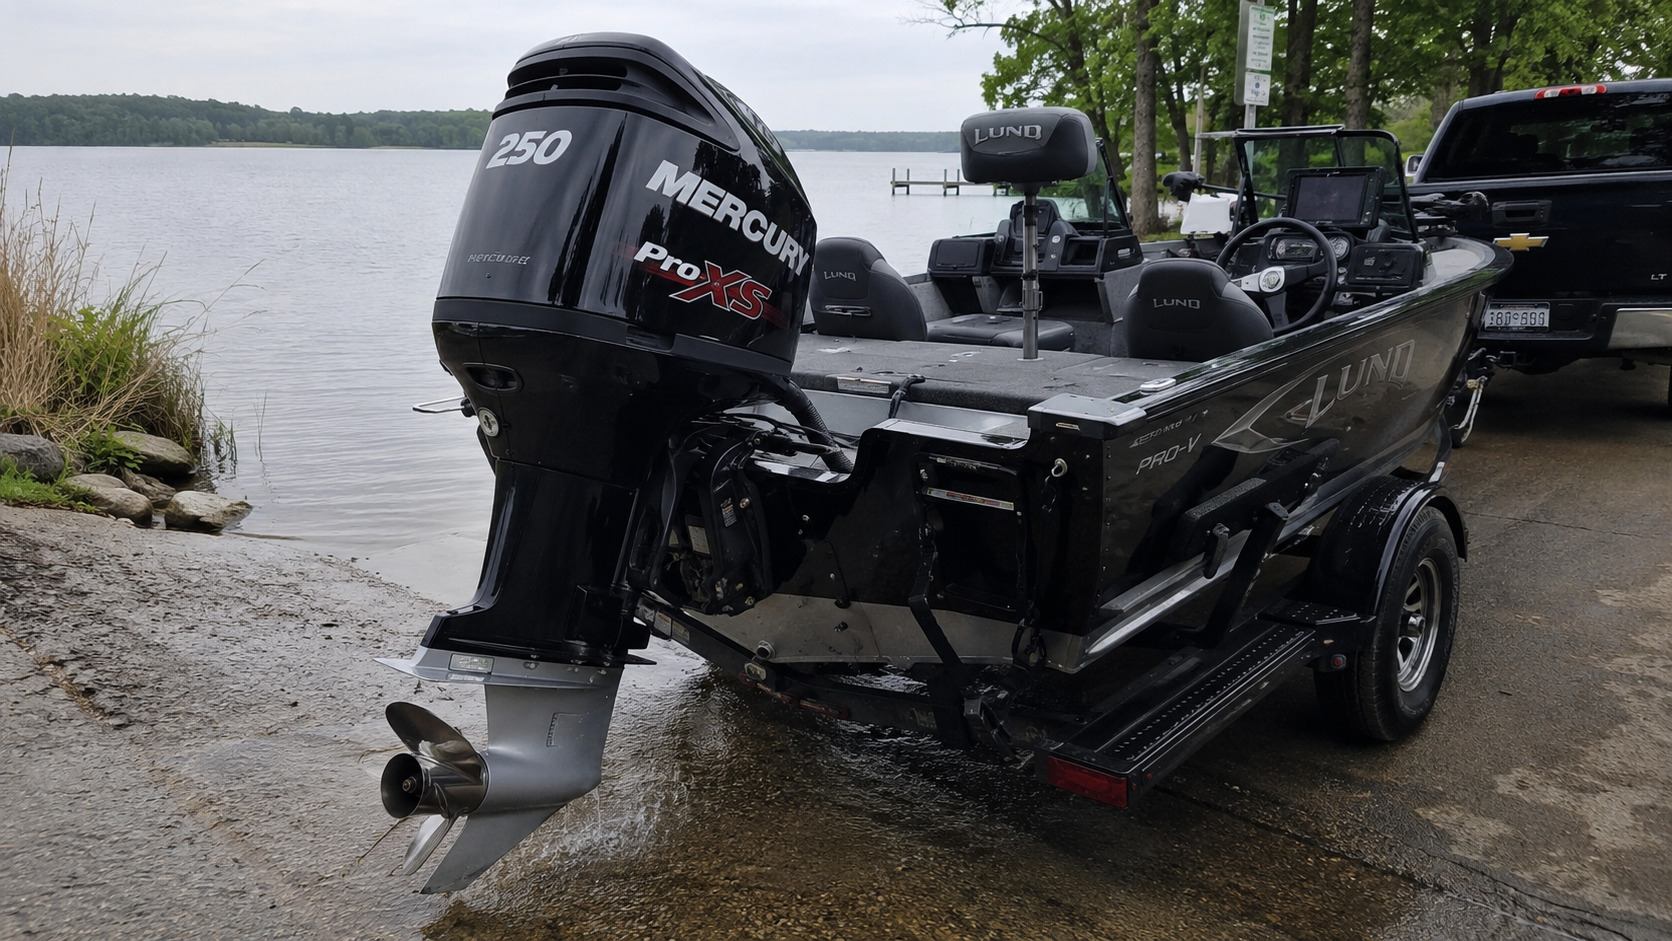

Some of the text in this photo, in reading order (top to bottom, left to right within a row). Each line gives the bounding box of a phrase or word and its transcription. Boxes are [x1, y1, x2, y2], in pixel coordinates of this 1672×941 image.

[485, 129, 573, 169] 250
[974, 124, 1042, 145] LUND
[645, 159, 811, 277] MERCURY
[633, 240, 773, 320] Pro XS
[823, 270, 857, 282] LUND
[1650, 273, 1668, 281] LT
[1152, 298, 1201, 310] LUND
[1304, 338, 1416, 429] LUND
[1135, 432, 1203, 476] PRO-V
